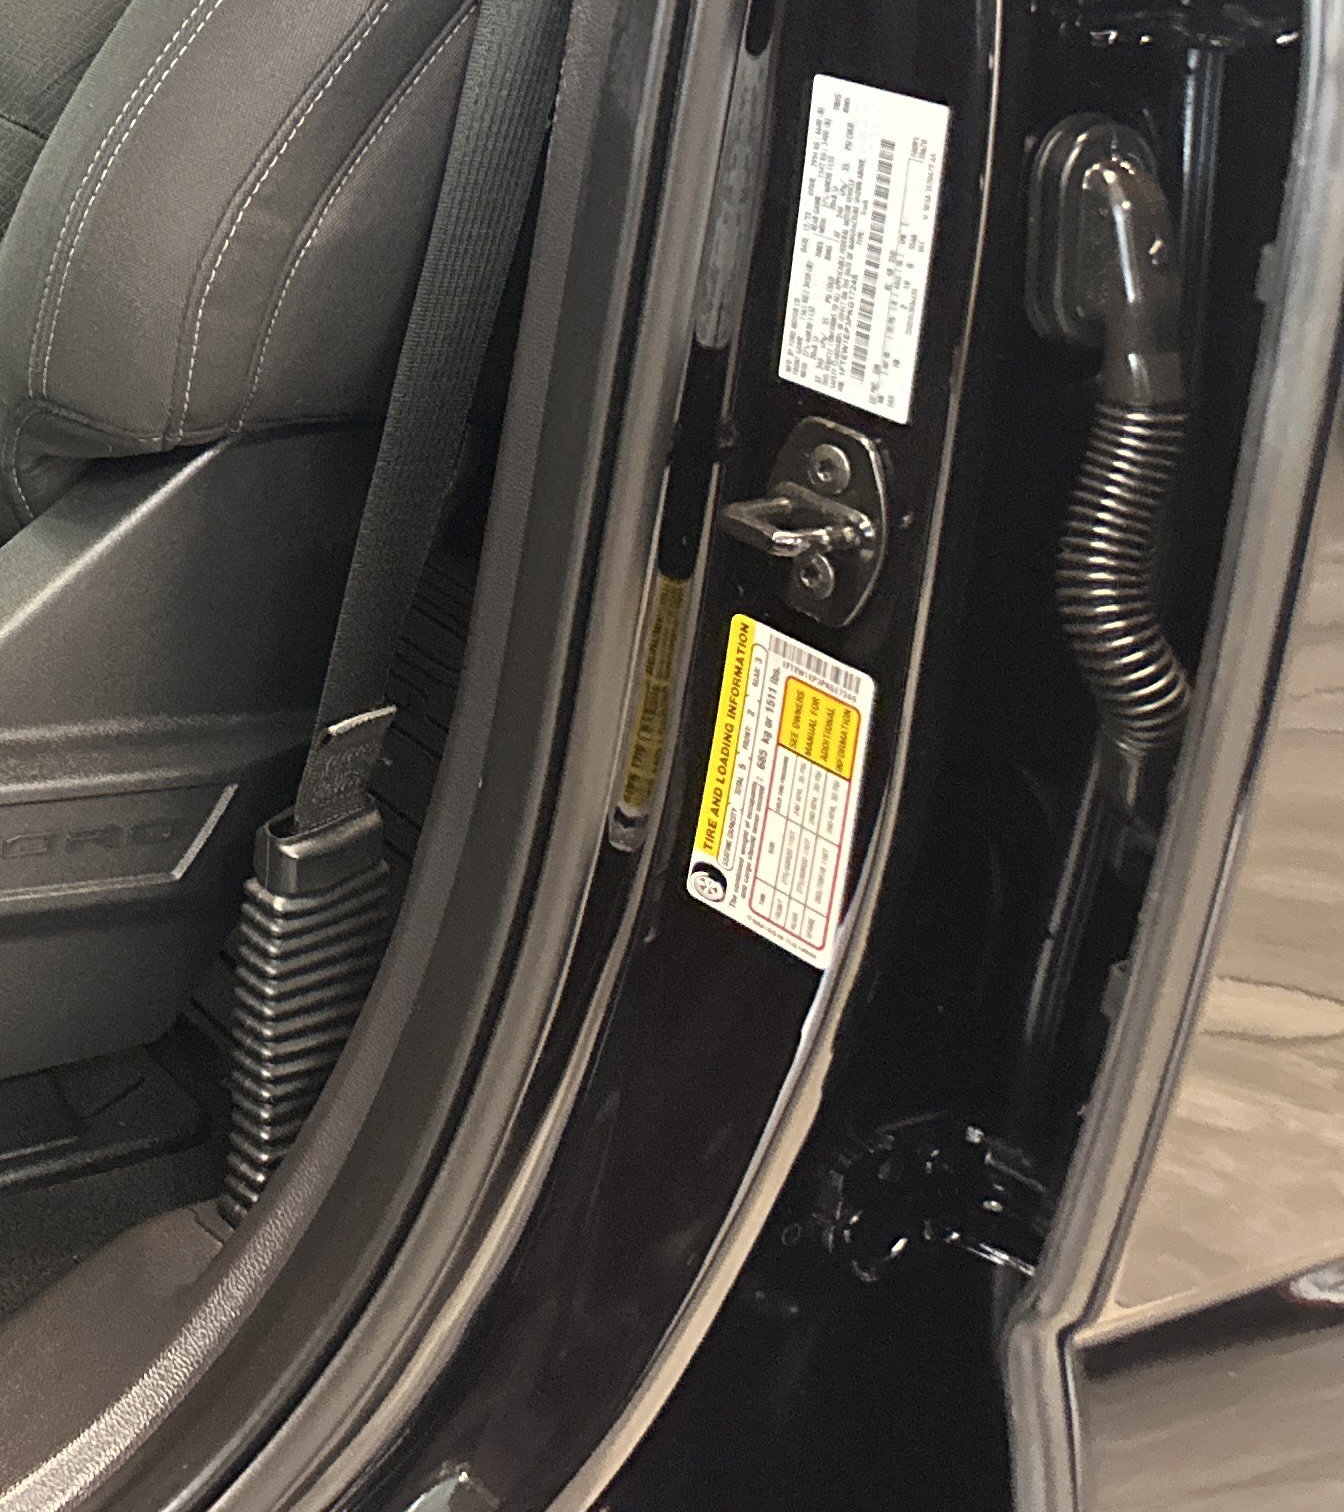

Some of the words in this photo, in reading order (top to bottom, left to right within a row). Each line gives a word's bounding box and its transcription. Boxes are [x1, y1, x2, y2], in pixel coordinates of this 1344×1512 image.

[725, 621, 750, 719] INFORMATION
[760, 728, 772, 745] kg
[763, 714, 773, 729] or
[715, 720, 734, 785] LOADING
[709, 785, 723, 817] AND
[703, 816, 717, 853] TIRE
